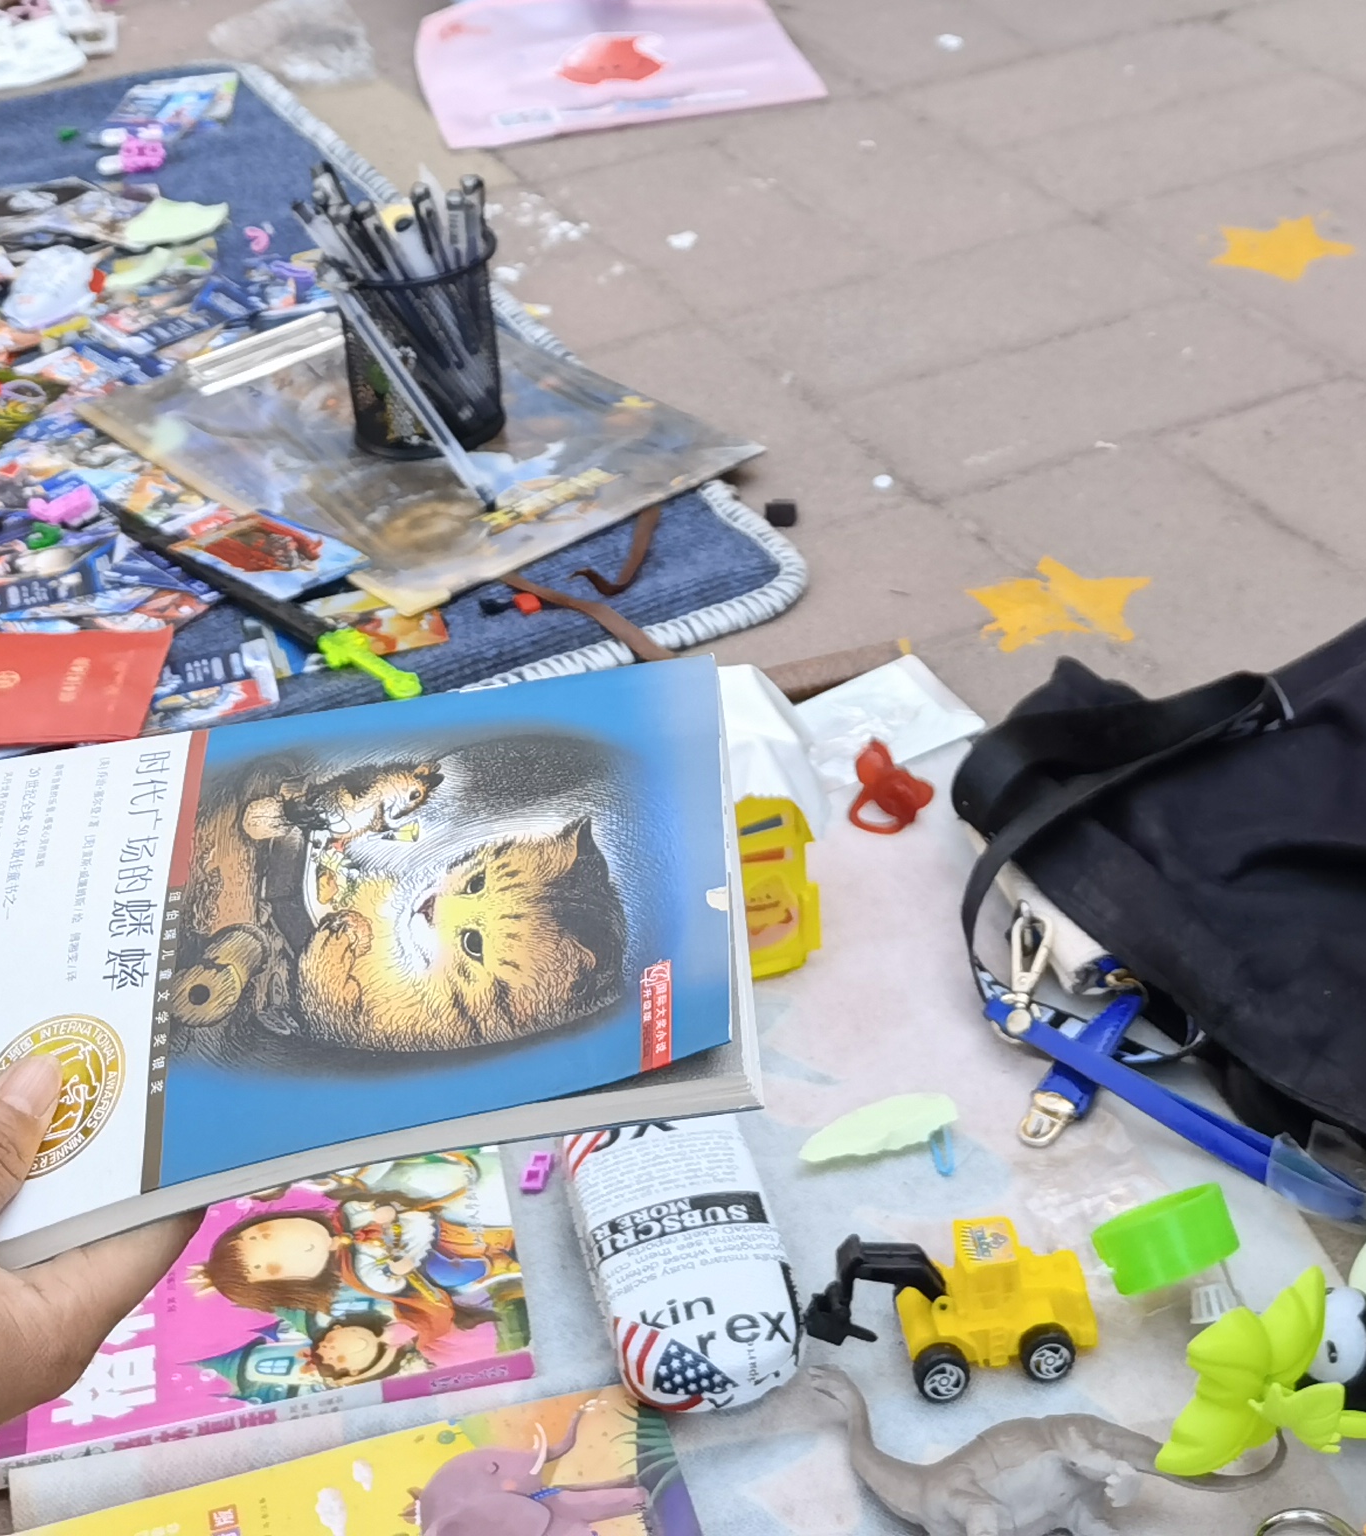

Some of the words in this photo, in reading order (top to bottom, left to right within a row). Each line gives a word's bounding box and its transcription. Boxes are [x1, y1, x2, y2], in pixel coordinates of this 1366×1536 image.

[103, 751, 171, 992] 时代广场的蟋蟀
[150, 891, 182, 1094] 纽伯瑞儿童文学奖银奖
[39, 1020, 115, 1066] INTERNATIONAL
[85, 1070, 117, 1129] AWARDS
[592, 1204, 749, 1260] SUBSCRI
[625, 1197, 691, 1229] MORE
[639, 1296, 716, 1330] kin
